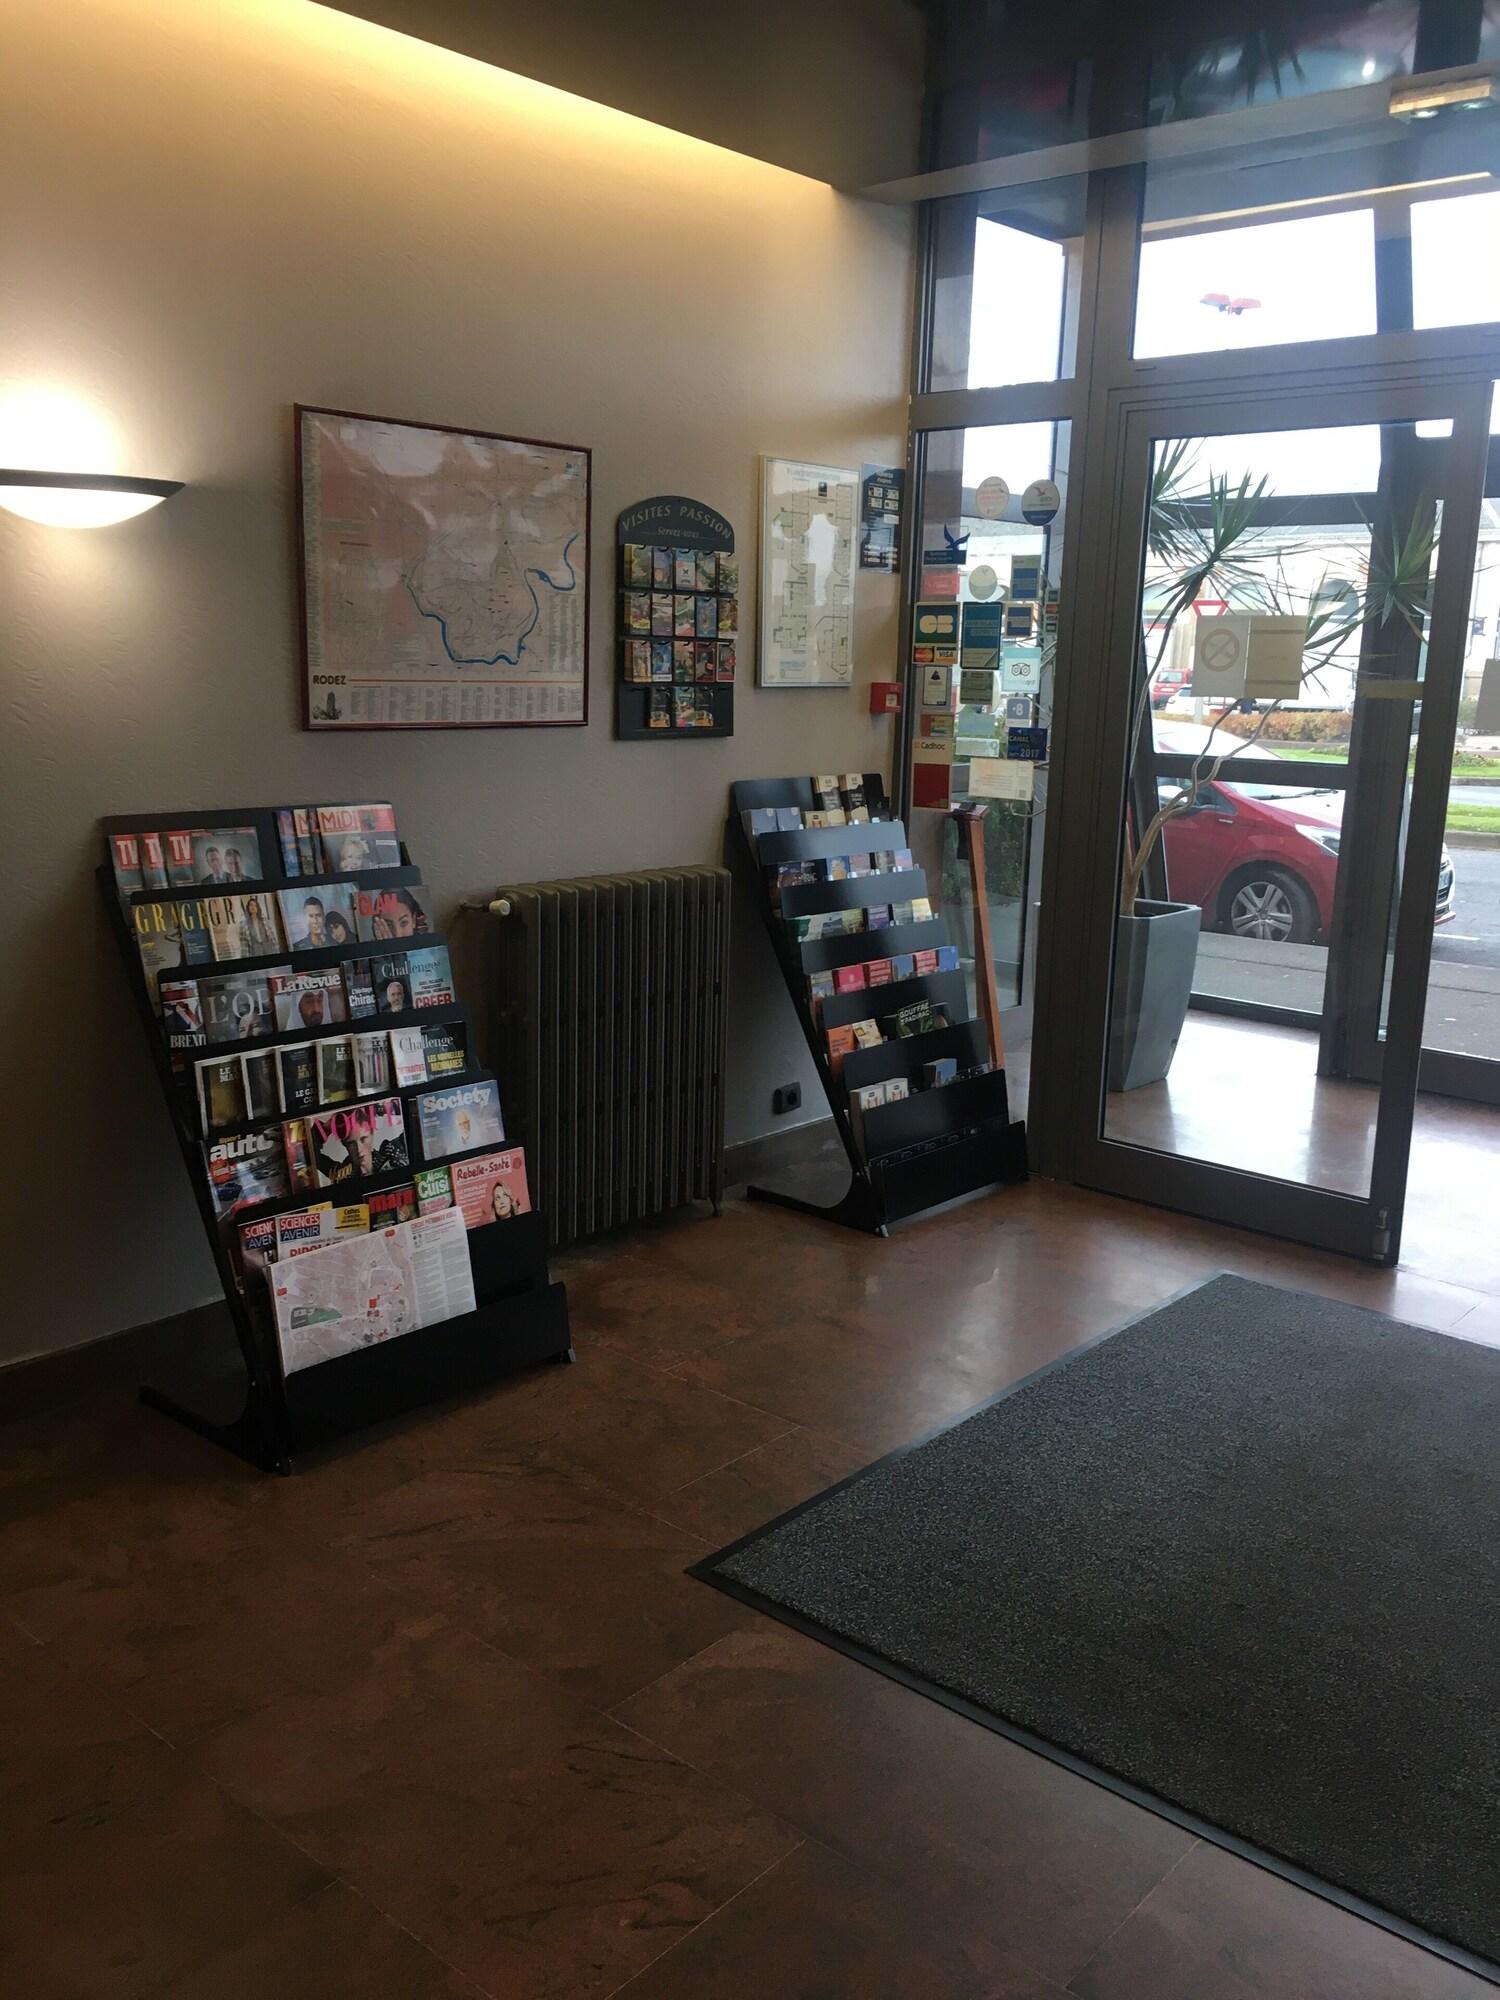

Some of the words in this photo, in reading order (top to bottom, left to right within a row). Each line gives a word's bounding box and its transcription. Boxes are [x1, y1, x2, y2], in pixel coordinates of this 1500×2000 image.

[622, 505, 672, 531] VISITES
[680, 506, 733, 539] PASSION
[313, 674, 346, 685] RODEZ
[920, 741, 945, 750] Cadhoc
[116, 839, 139, 865] TV
[168, 836, 191, 860] TV
[423, 1086, 491, 1112] Society
[312, 1099, 401, 1144] VOGUE
[280, 1214, 320, 1230] SCIENCES
[283, 1226, 320, 1241] AVENIR
